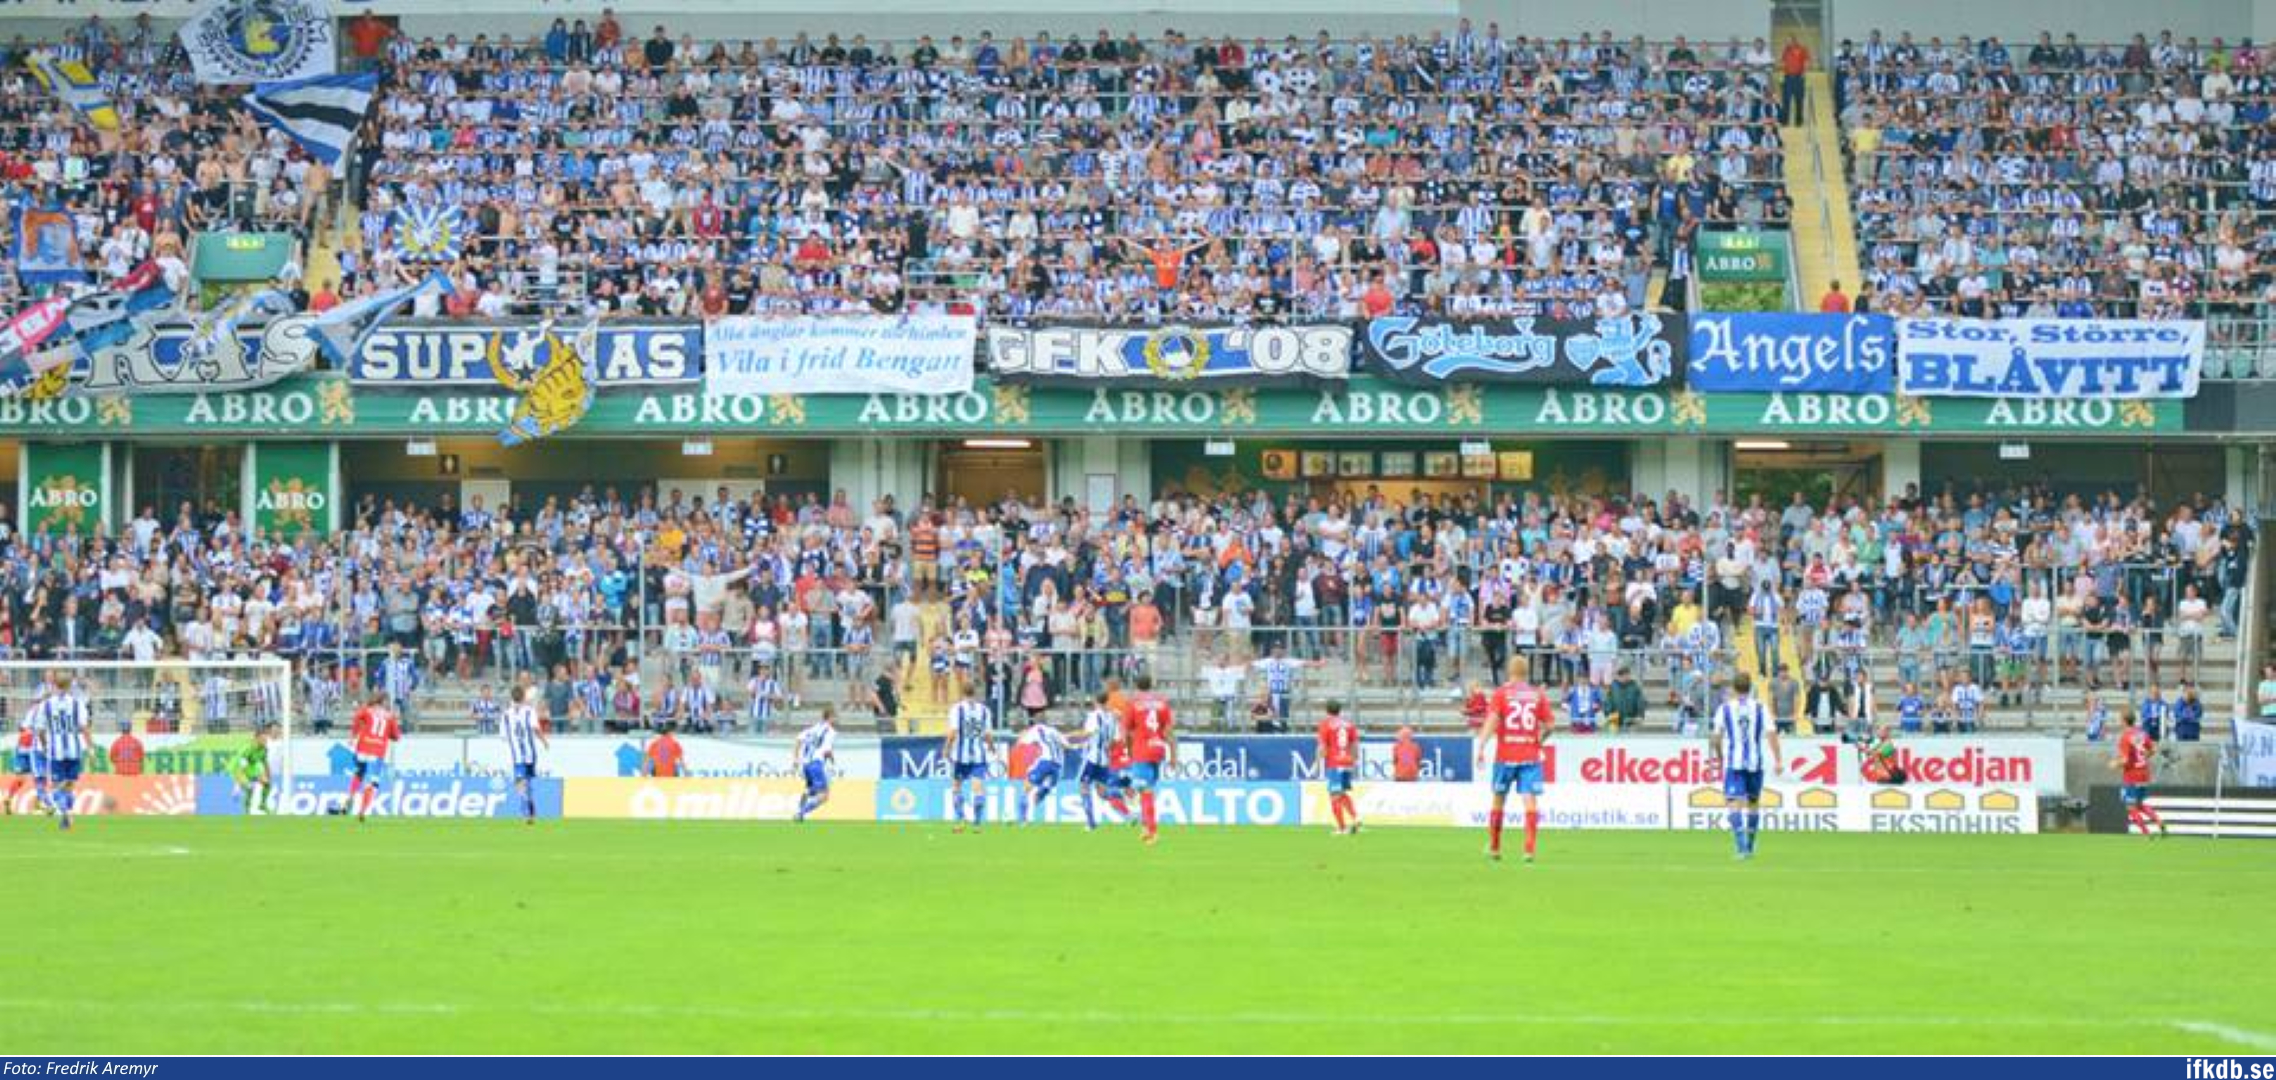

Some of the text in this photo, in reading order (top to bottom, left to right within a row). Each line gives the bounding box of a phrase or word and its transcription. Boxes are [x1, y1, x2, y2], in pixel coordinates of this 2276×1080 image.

[1368, 317, 1556, 370] Göteborg
[1691, 316, 1886, 385] Angels
[1906, 321, 2190, 346] Stor, Större,
[718, 348, 771, 374] Vila
[780, 346, 791, 373] i
[793, 345, 849, 379] frid
[1905, 347, 2190, 394] BLÅVITT
[1145, 709, 1160, 733] 4
[1505, 701, 1537, 730] 26
